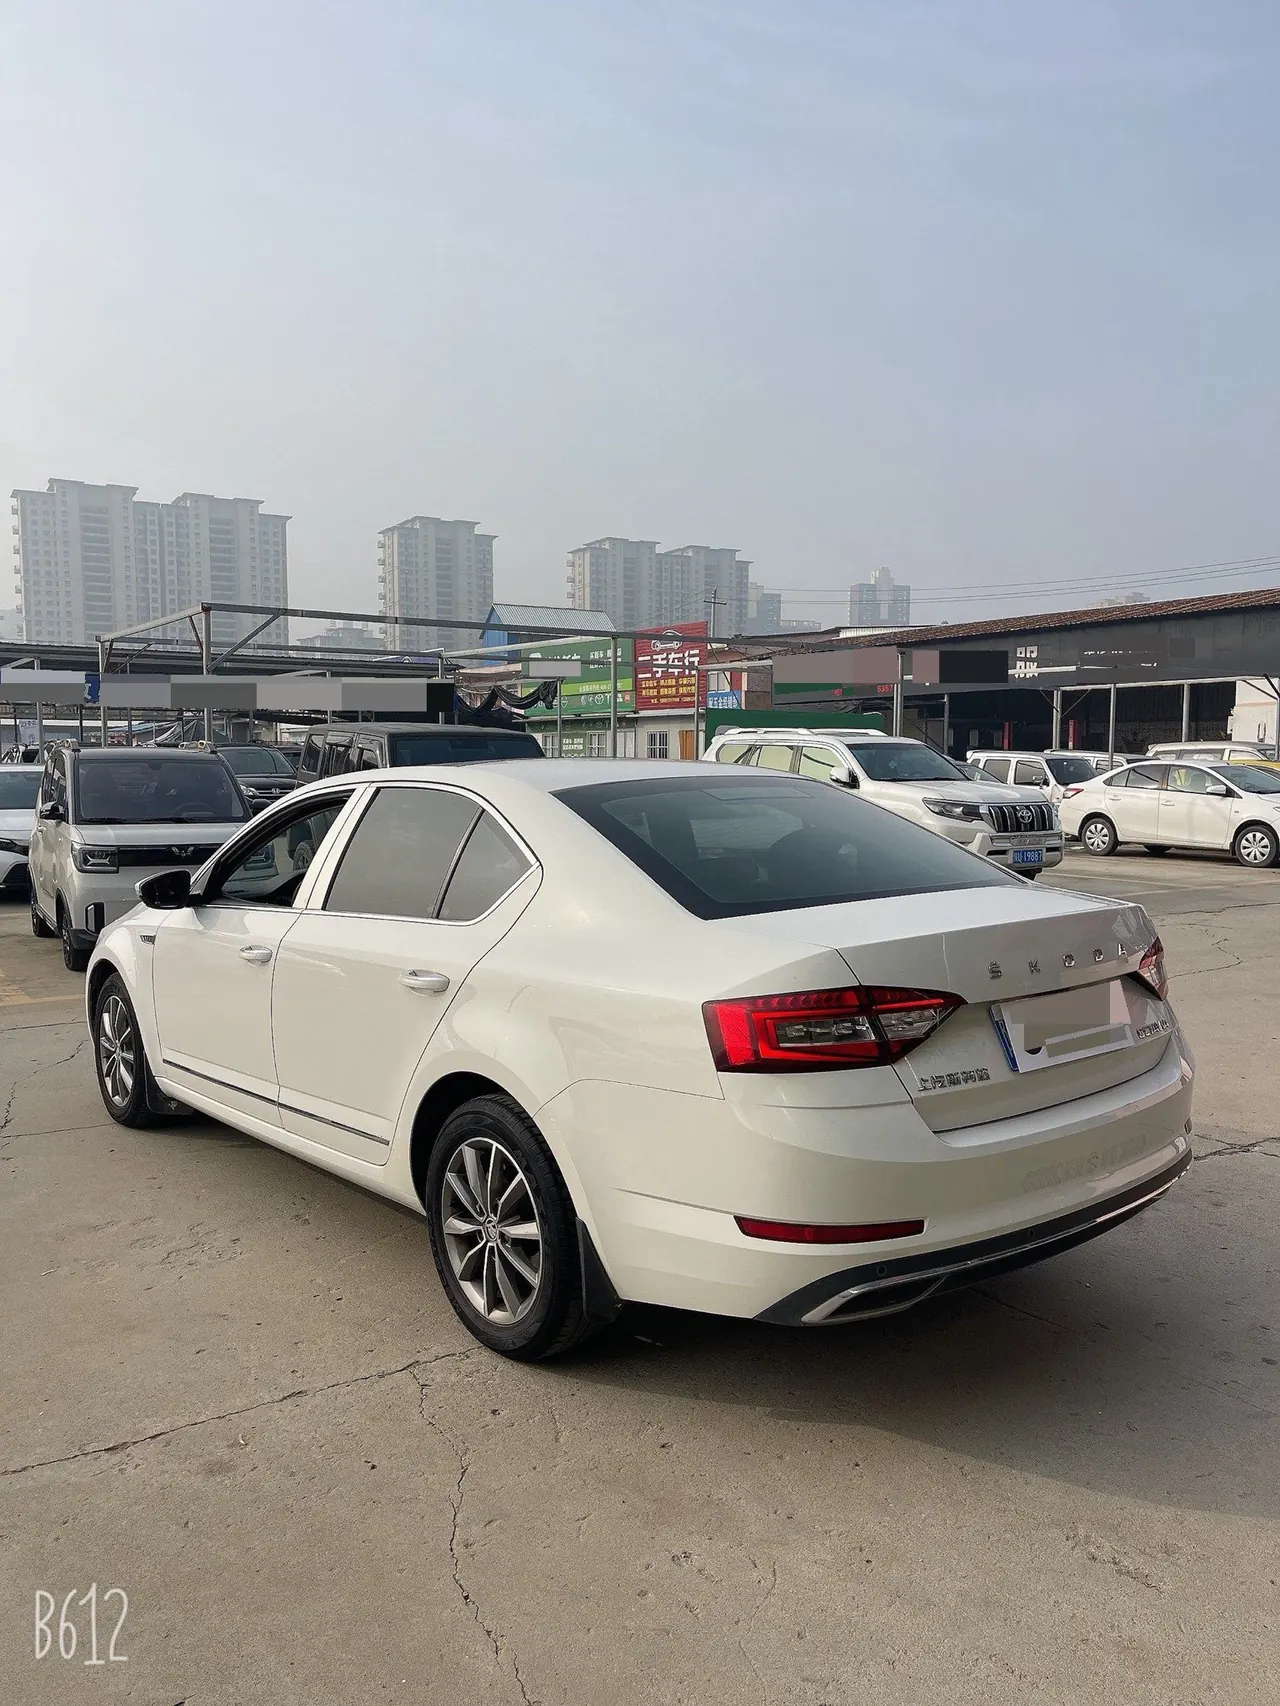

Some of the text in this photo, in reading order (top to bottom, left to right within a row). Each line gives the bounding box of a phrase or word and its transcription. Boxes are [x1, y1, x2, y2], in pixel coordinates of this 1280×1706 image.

[638, 650, 700, 678] 二手车行
[918, 1067, 991, 1092] 上汽斯柯达
